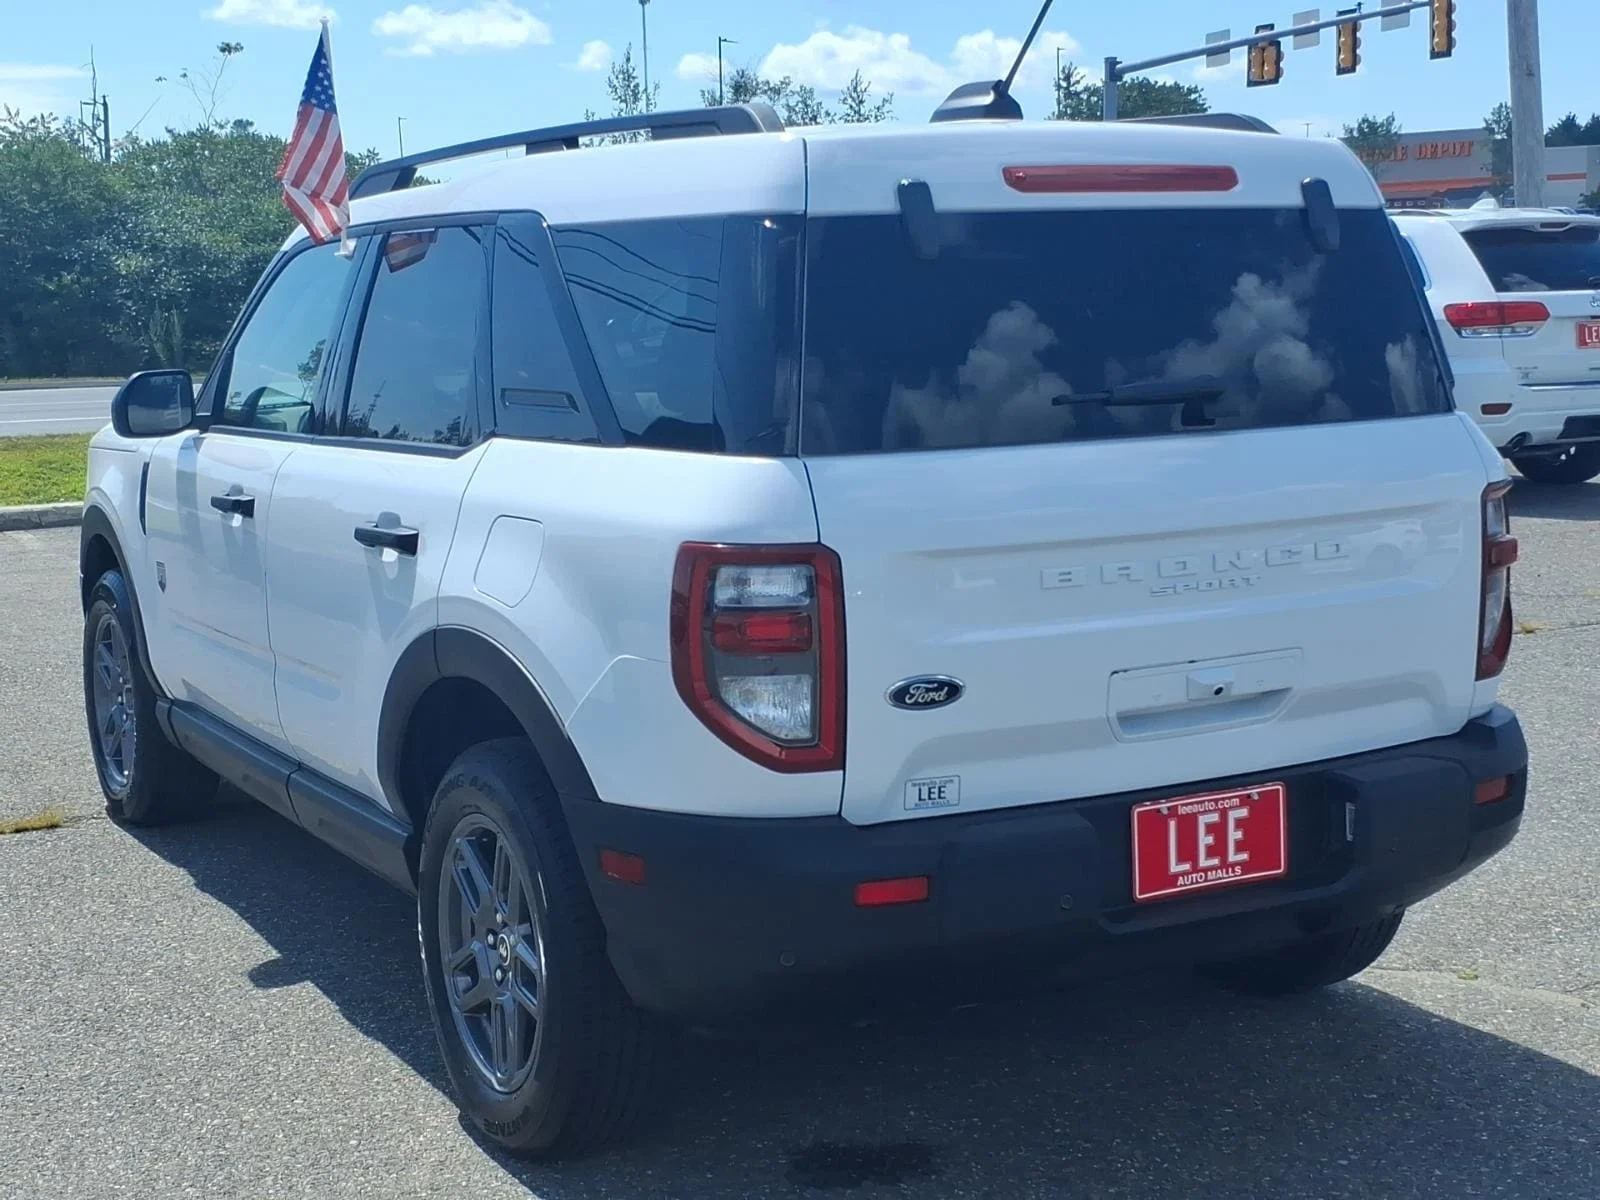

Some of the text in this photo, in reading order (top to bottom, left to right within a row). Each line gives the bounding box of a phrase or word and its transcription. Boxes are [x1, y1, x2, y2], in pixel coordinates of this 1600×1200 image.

[1412, 141, 1474, 161] DEPOT
[1040, 540, 1350, 591] BRONCO
[1150, 576, 1262, 598] SPORT
[904, 683, 949, 704] Ford
[917, 785, 948, 802] LEE
[1177, 798, 1241, 816] leeauto.com
[1167, 806, 1250, 875] LEE
[1177, 865, 1243, 887] AUTO MALLS
